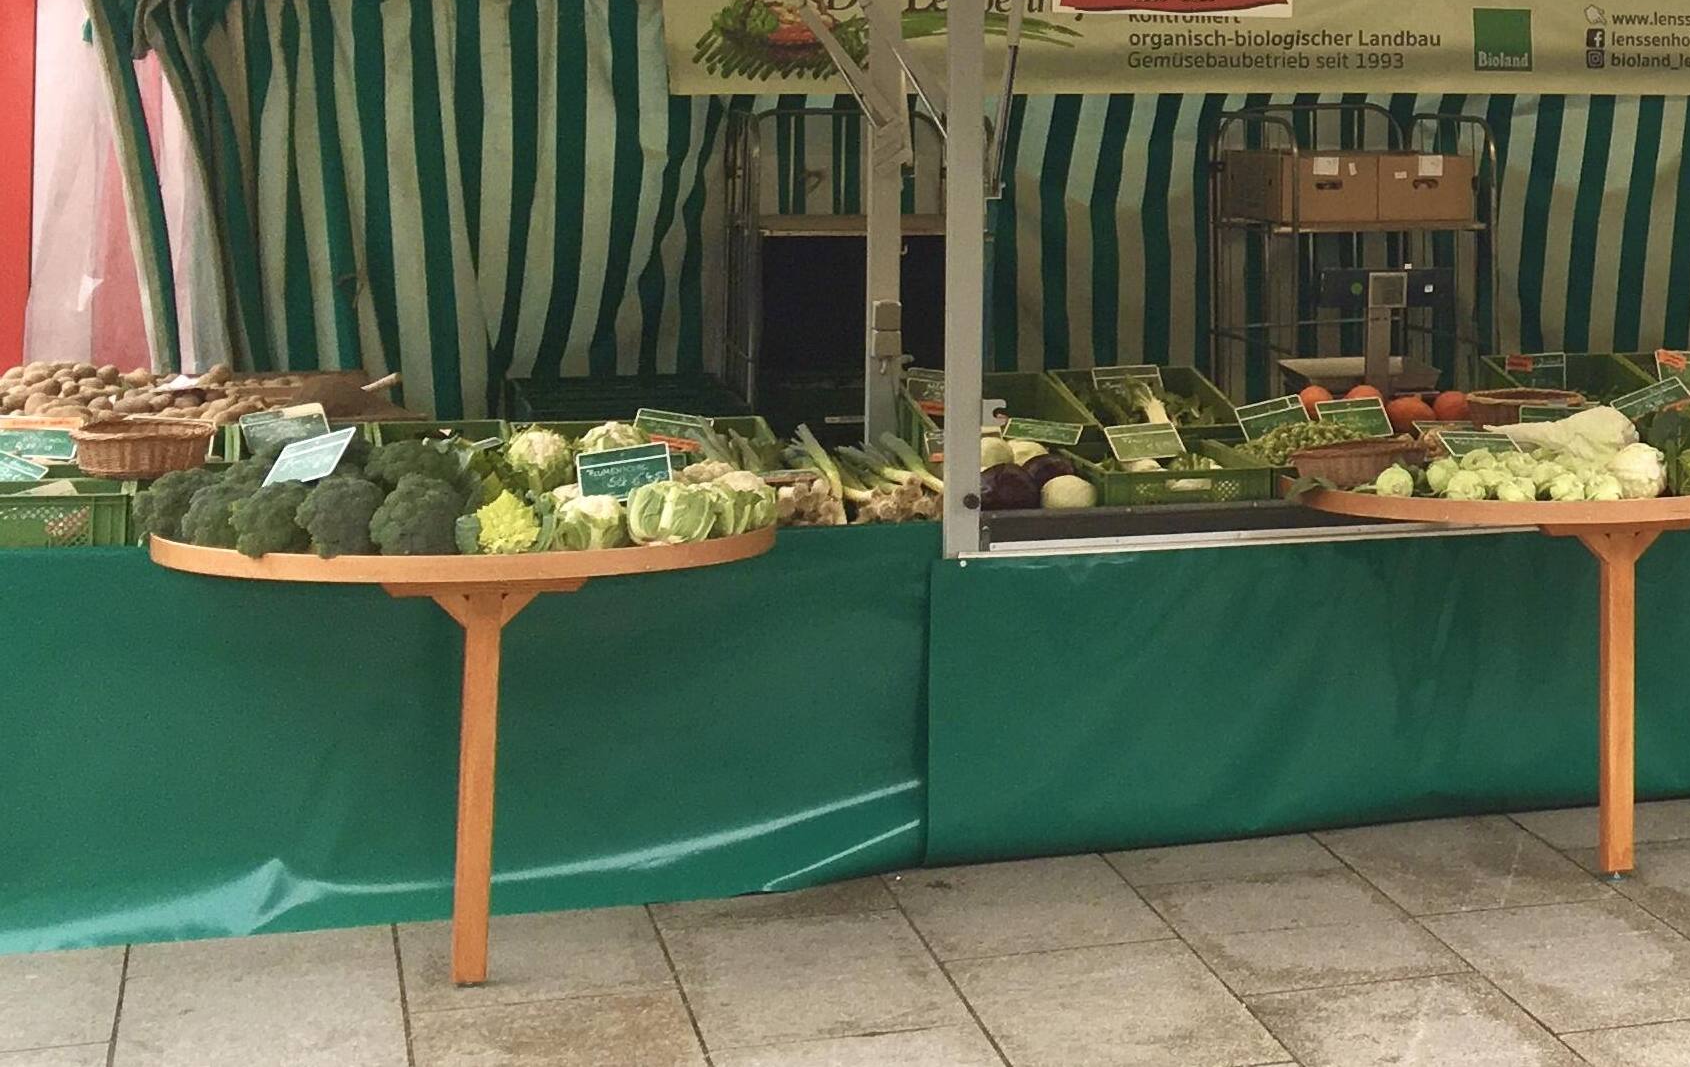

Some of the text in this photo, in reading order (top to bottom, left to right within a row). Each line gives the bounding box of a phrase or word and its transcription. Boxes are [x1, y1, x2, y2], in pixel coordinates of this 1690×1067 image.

[1129, 30, 1441, 49] organisch-biologischer Landbau
[1128, 51, 1404, 69] Gemüsebaubetrieb seit 1993
[1478, 51, 1529, 68] Bioland
